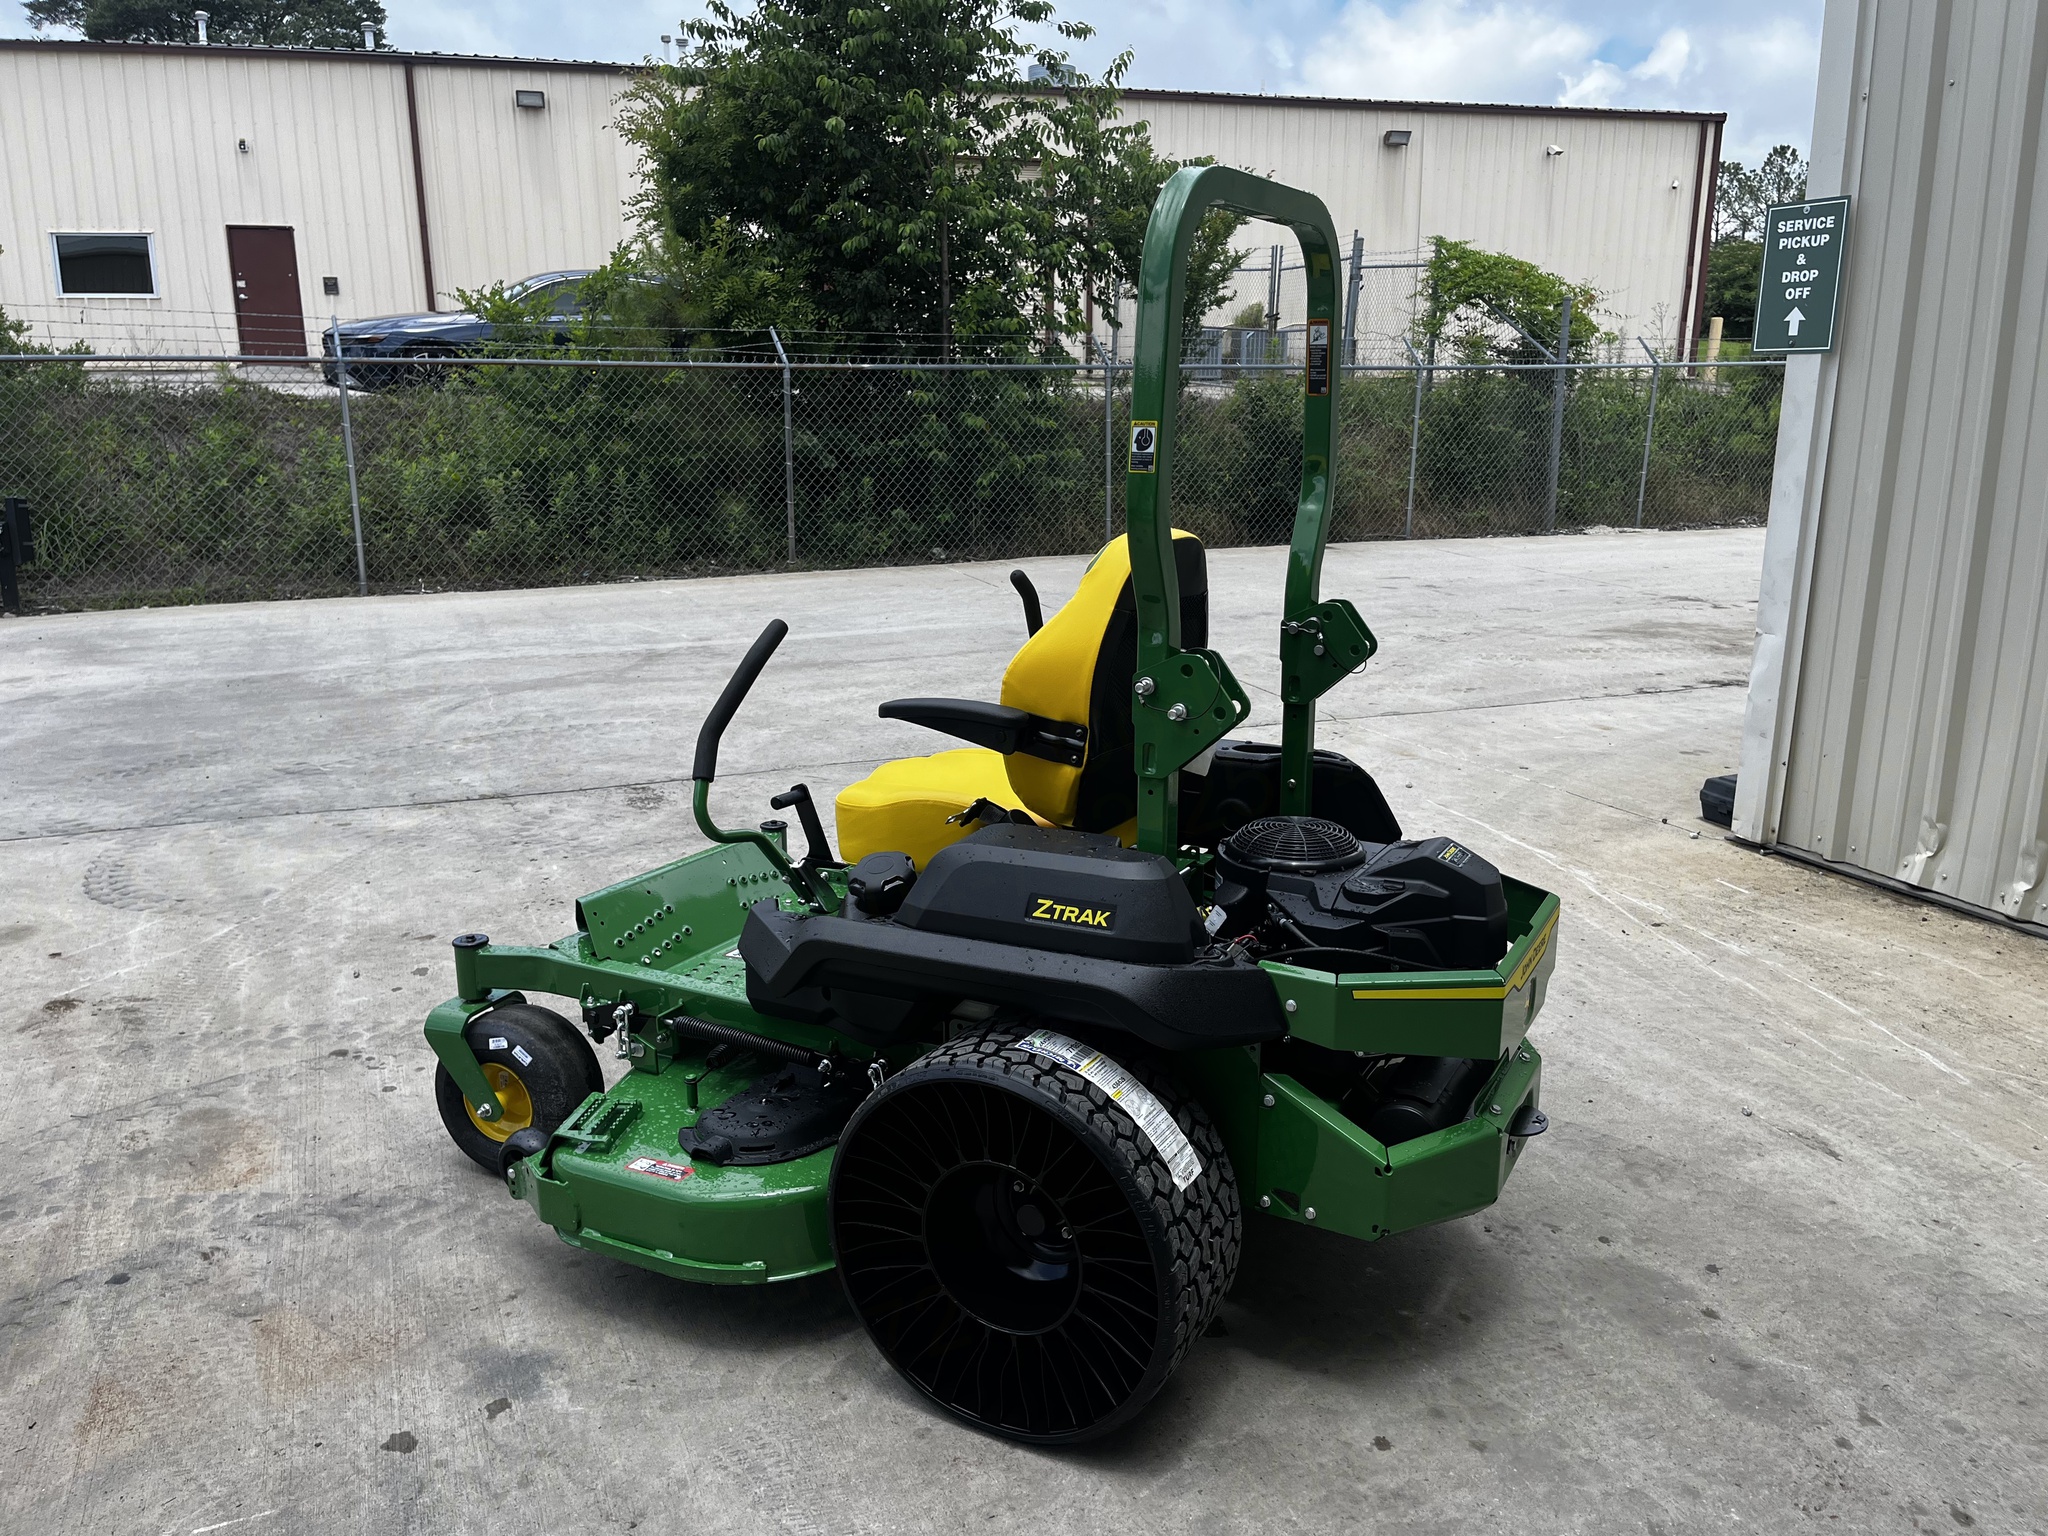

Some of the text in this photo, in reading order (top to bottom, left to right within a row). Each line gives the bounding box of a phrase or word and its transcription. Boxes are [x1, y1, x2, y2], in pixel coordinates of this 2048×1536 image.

[1777, 216, 1835, 233] SERVICE
[1779, 234, 1830, 249] PICKUP
[1796, 254, 1806, 265] &
[1781, 270, 1819, 283] DROP
[1785, 287, 1811, 300] OFF
[1183, 1168, 1194, 1182] TURF
